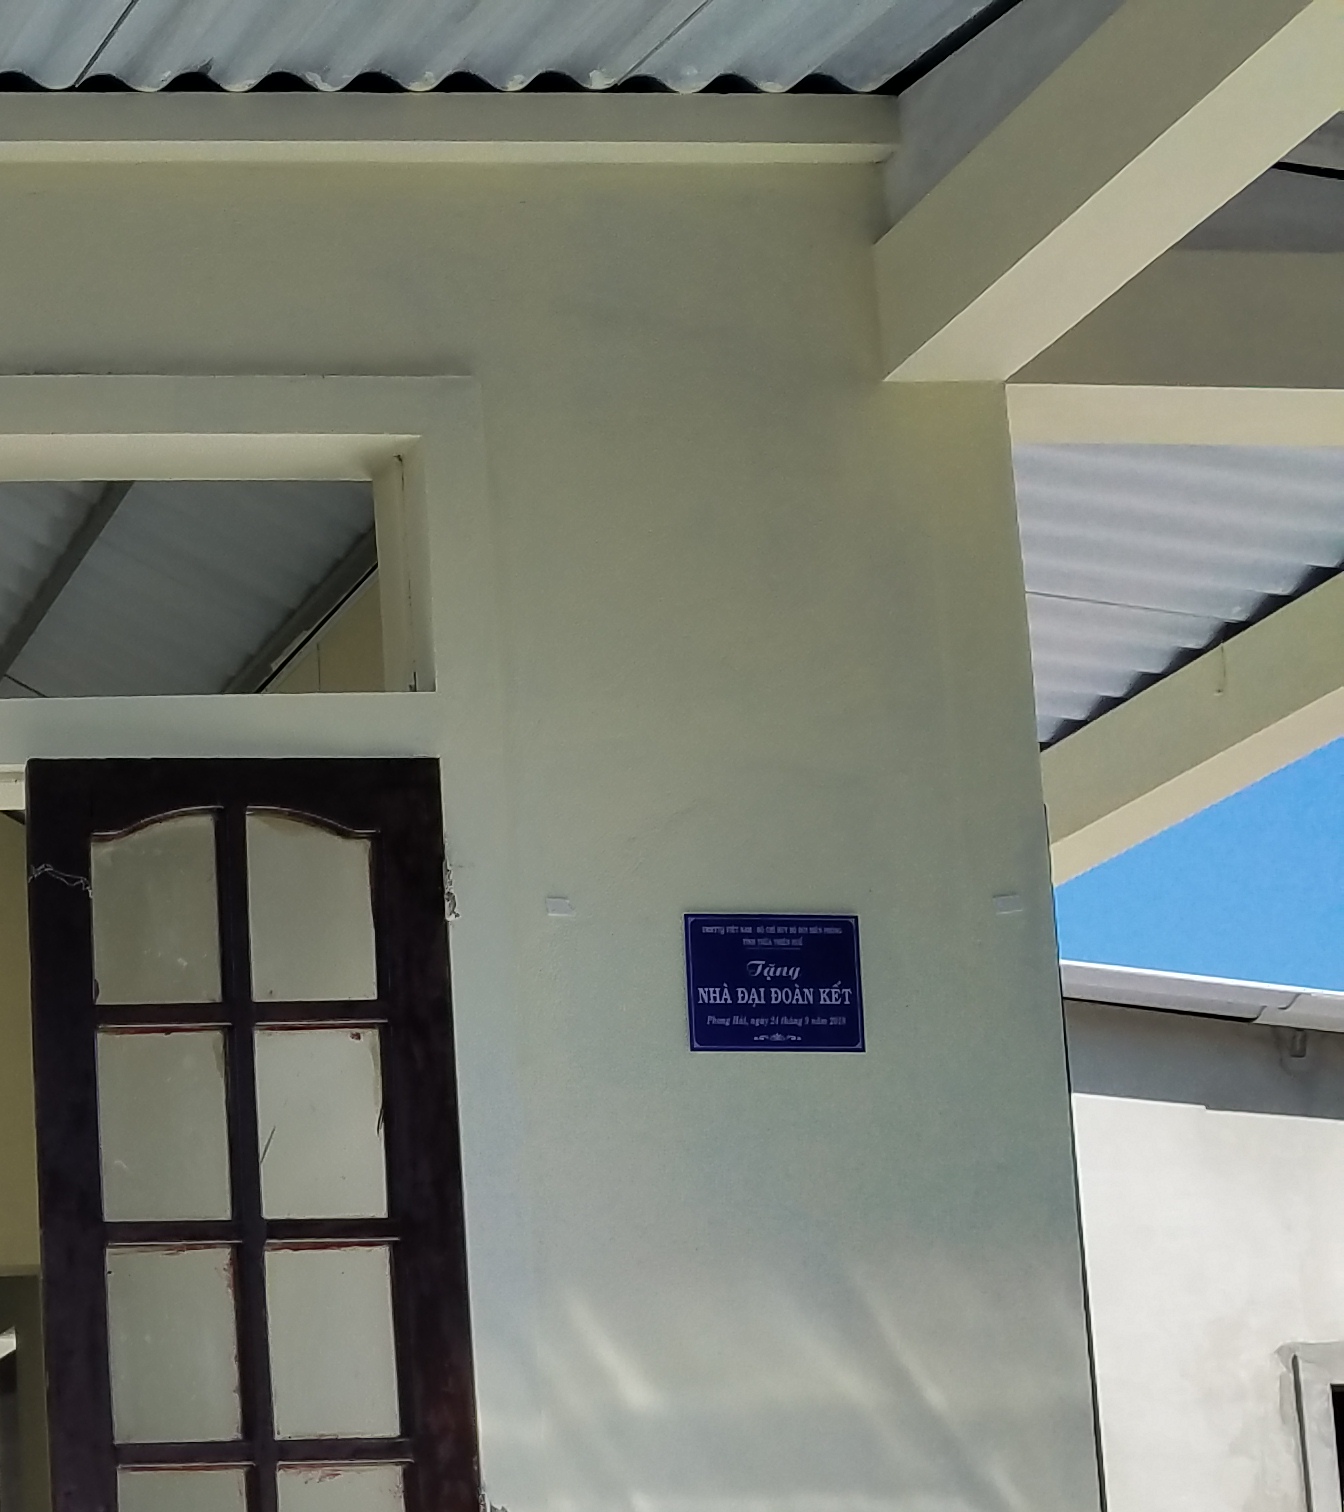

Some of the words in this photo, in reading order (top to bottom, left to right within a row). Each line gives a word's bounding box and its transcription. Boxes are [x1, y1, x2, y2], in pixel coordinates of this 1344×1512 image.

[746, 960, 801, 981] Tặng
[697, 982, 732, 1004] NHÀ
[736, 987, 766, 1008] ĐẠI
[770, 983, 814, 1005] ĐOÀN
[819, 980, 852, 1005] KẾT
